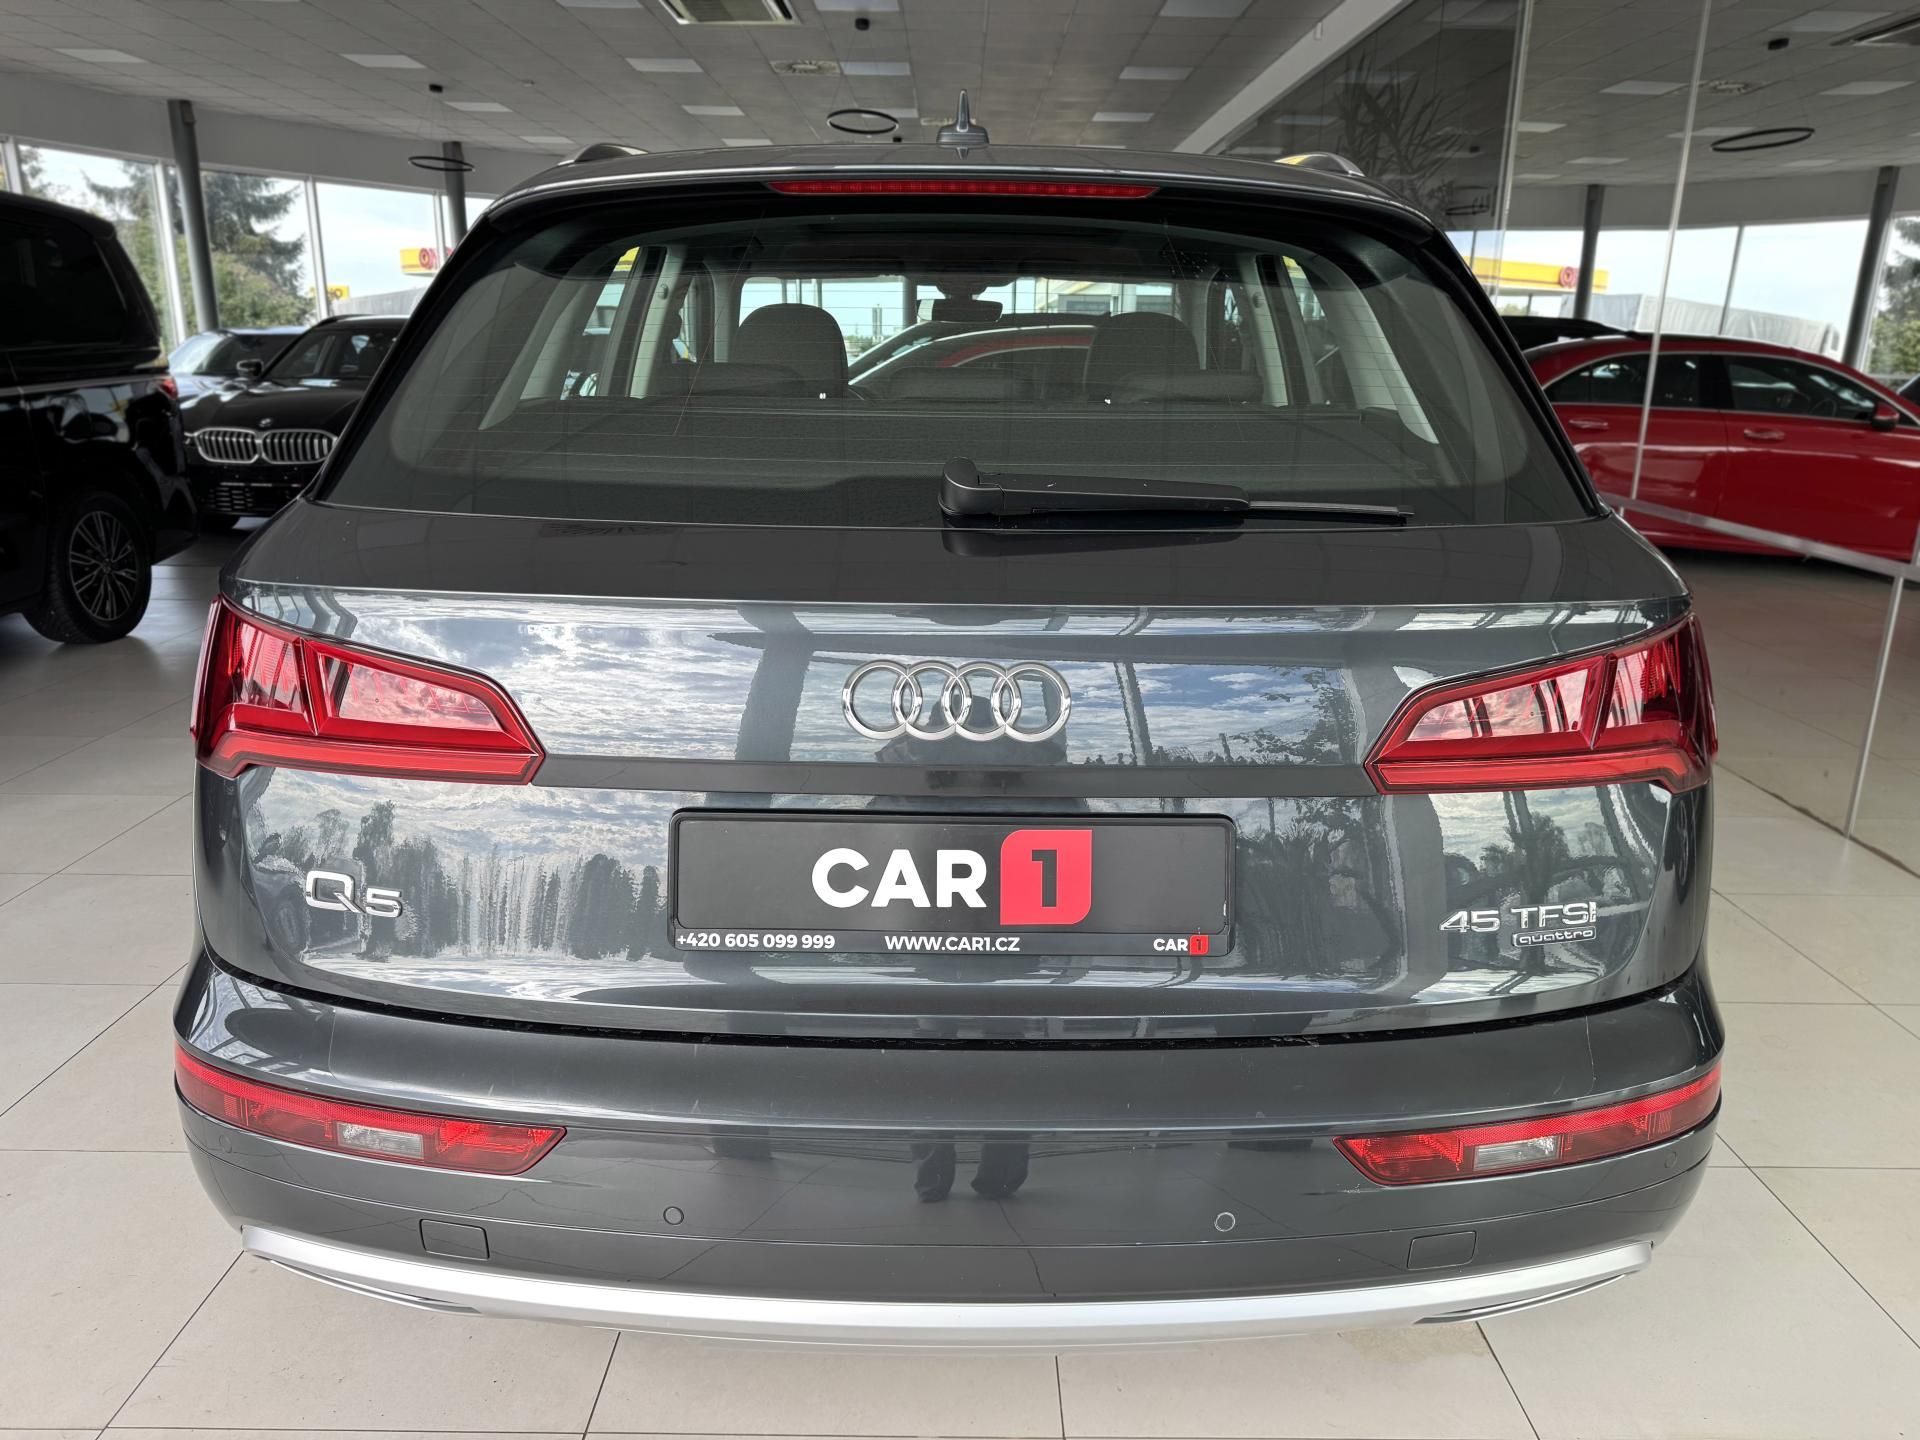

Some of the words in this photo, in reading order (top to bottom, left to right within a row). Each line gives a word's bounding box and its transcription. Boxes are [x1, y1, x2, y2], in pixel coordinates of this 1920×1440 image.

[812, 847, 987, 909] CAR
[305, 870, 402, 918] Q5
[1439, 909, 1500, 933] 45
[1511, 901, 1597, 929] TFSI
[677, 932, 721, 948] +420
[725, 933, 759, 948] 605
[763, 934, 798, 949] 099
[801, 935, 836, 949] 999
[884, 935, 1021, 952] WWW.CAR1.CZ
[1153, 938, 1189, 952] CAR
[1519, 930, 1594, 945] quattro
